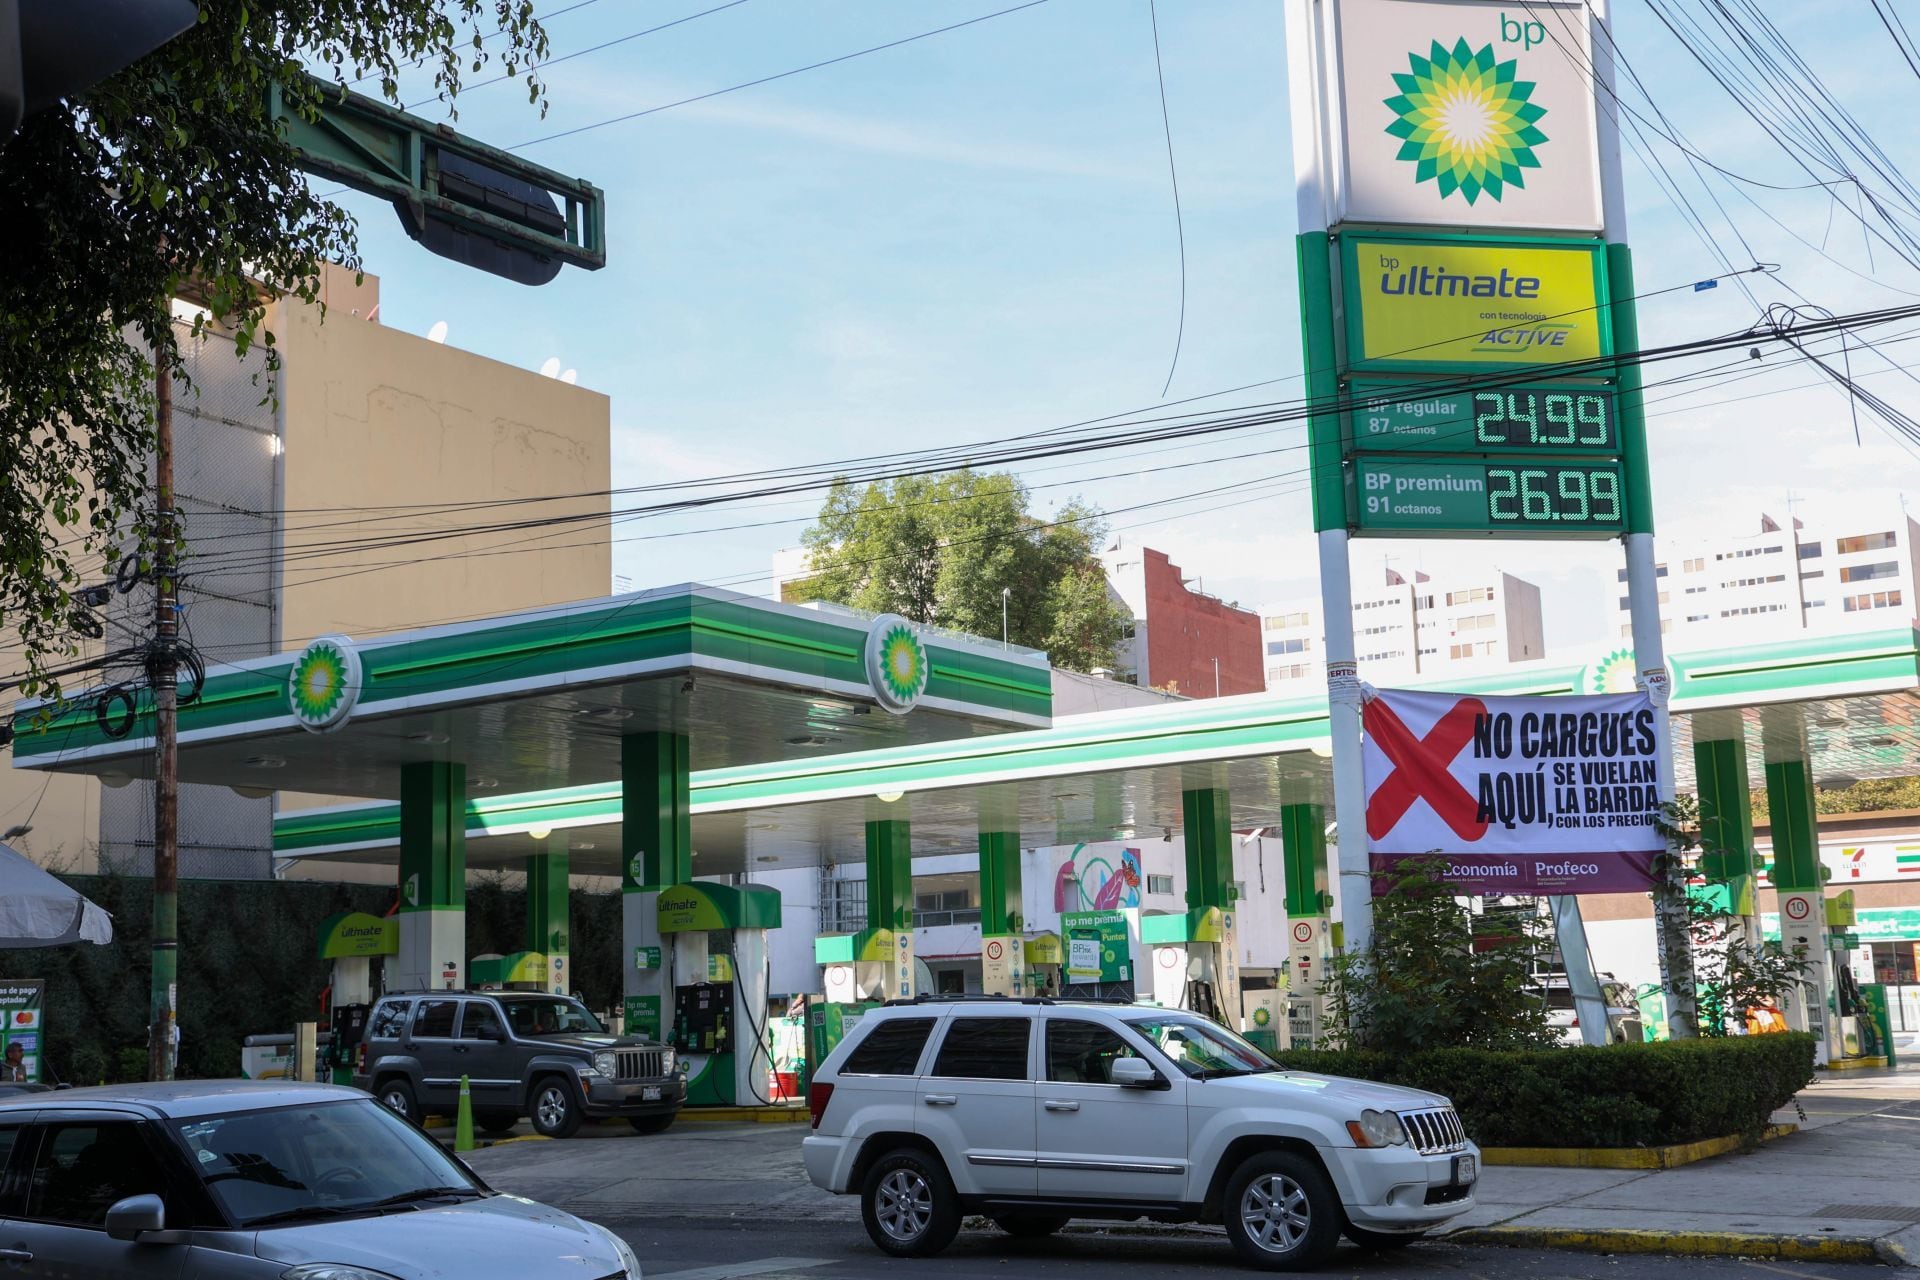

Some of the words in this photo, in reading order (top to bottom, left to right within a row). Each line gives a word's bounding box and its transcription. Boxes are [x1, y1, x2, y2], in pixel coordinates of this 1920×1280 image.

[1501, 13, 1545, 51] bp
[1380, 254, 1400, 271] bp
[1381, 266, 1540, 299] ultimate
[1479, 312, 1498, 320] con
[1479, 329, 1569, 347] ACTIVE
[1369, 418, 1390, 433] 87
[1393, 425, 1437, 435] octanos
[1396, 400, 1457, 417] regular
[1475, 392, 1607, 445] 24.99
[1365, 473, 1391, 490] BP
[1396, 474, 1484, 494] premium
[1488, 470, 1621, 521] 26.99
[1367, 496, 1390, 513] 91
[1394, 503, 1443, 515] octanos
[1474, 712, 1514, 759] NO
[1520, 709, 1656, 758] CARGUES
[1554, 762, 1576, 785] SE
[1581, 760, 1657, 785] VUELAN
[1476, 763, 1554, 829] AQUÍ,
[1555, 787, 1580, 814] LA
[1585, 784, 1659, 813] BARDA
[1556, 815, 1581, 828] CON
[1583, 815, 1605, 828] LOS
[1535, 861, 1599, 876] Profeco
[659, 899, 697, 912] ultimate
[1790, 901, 1804, 912] 10
[1065, 917, 1077, 928] bp
[1078, 917, 1093, 926] me
[1094, 913, 1124, 926] premia
[341, 926, 383, 937] ultimate
[1102, 933, 1126, 942] Puntos
[1298, 926, 1308, 936] 10
[990, 944, 1000, 954] 10
[19, 987, 37, 996] pago
